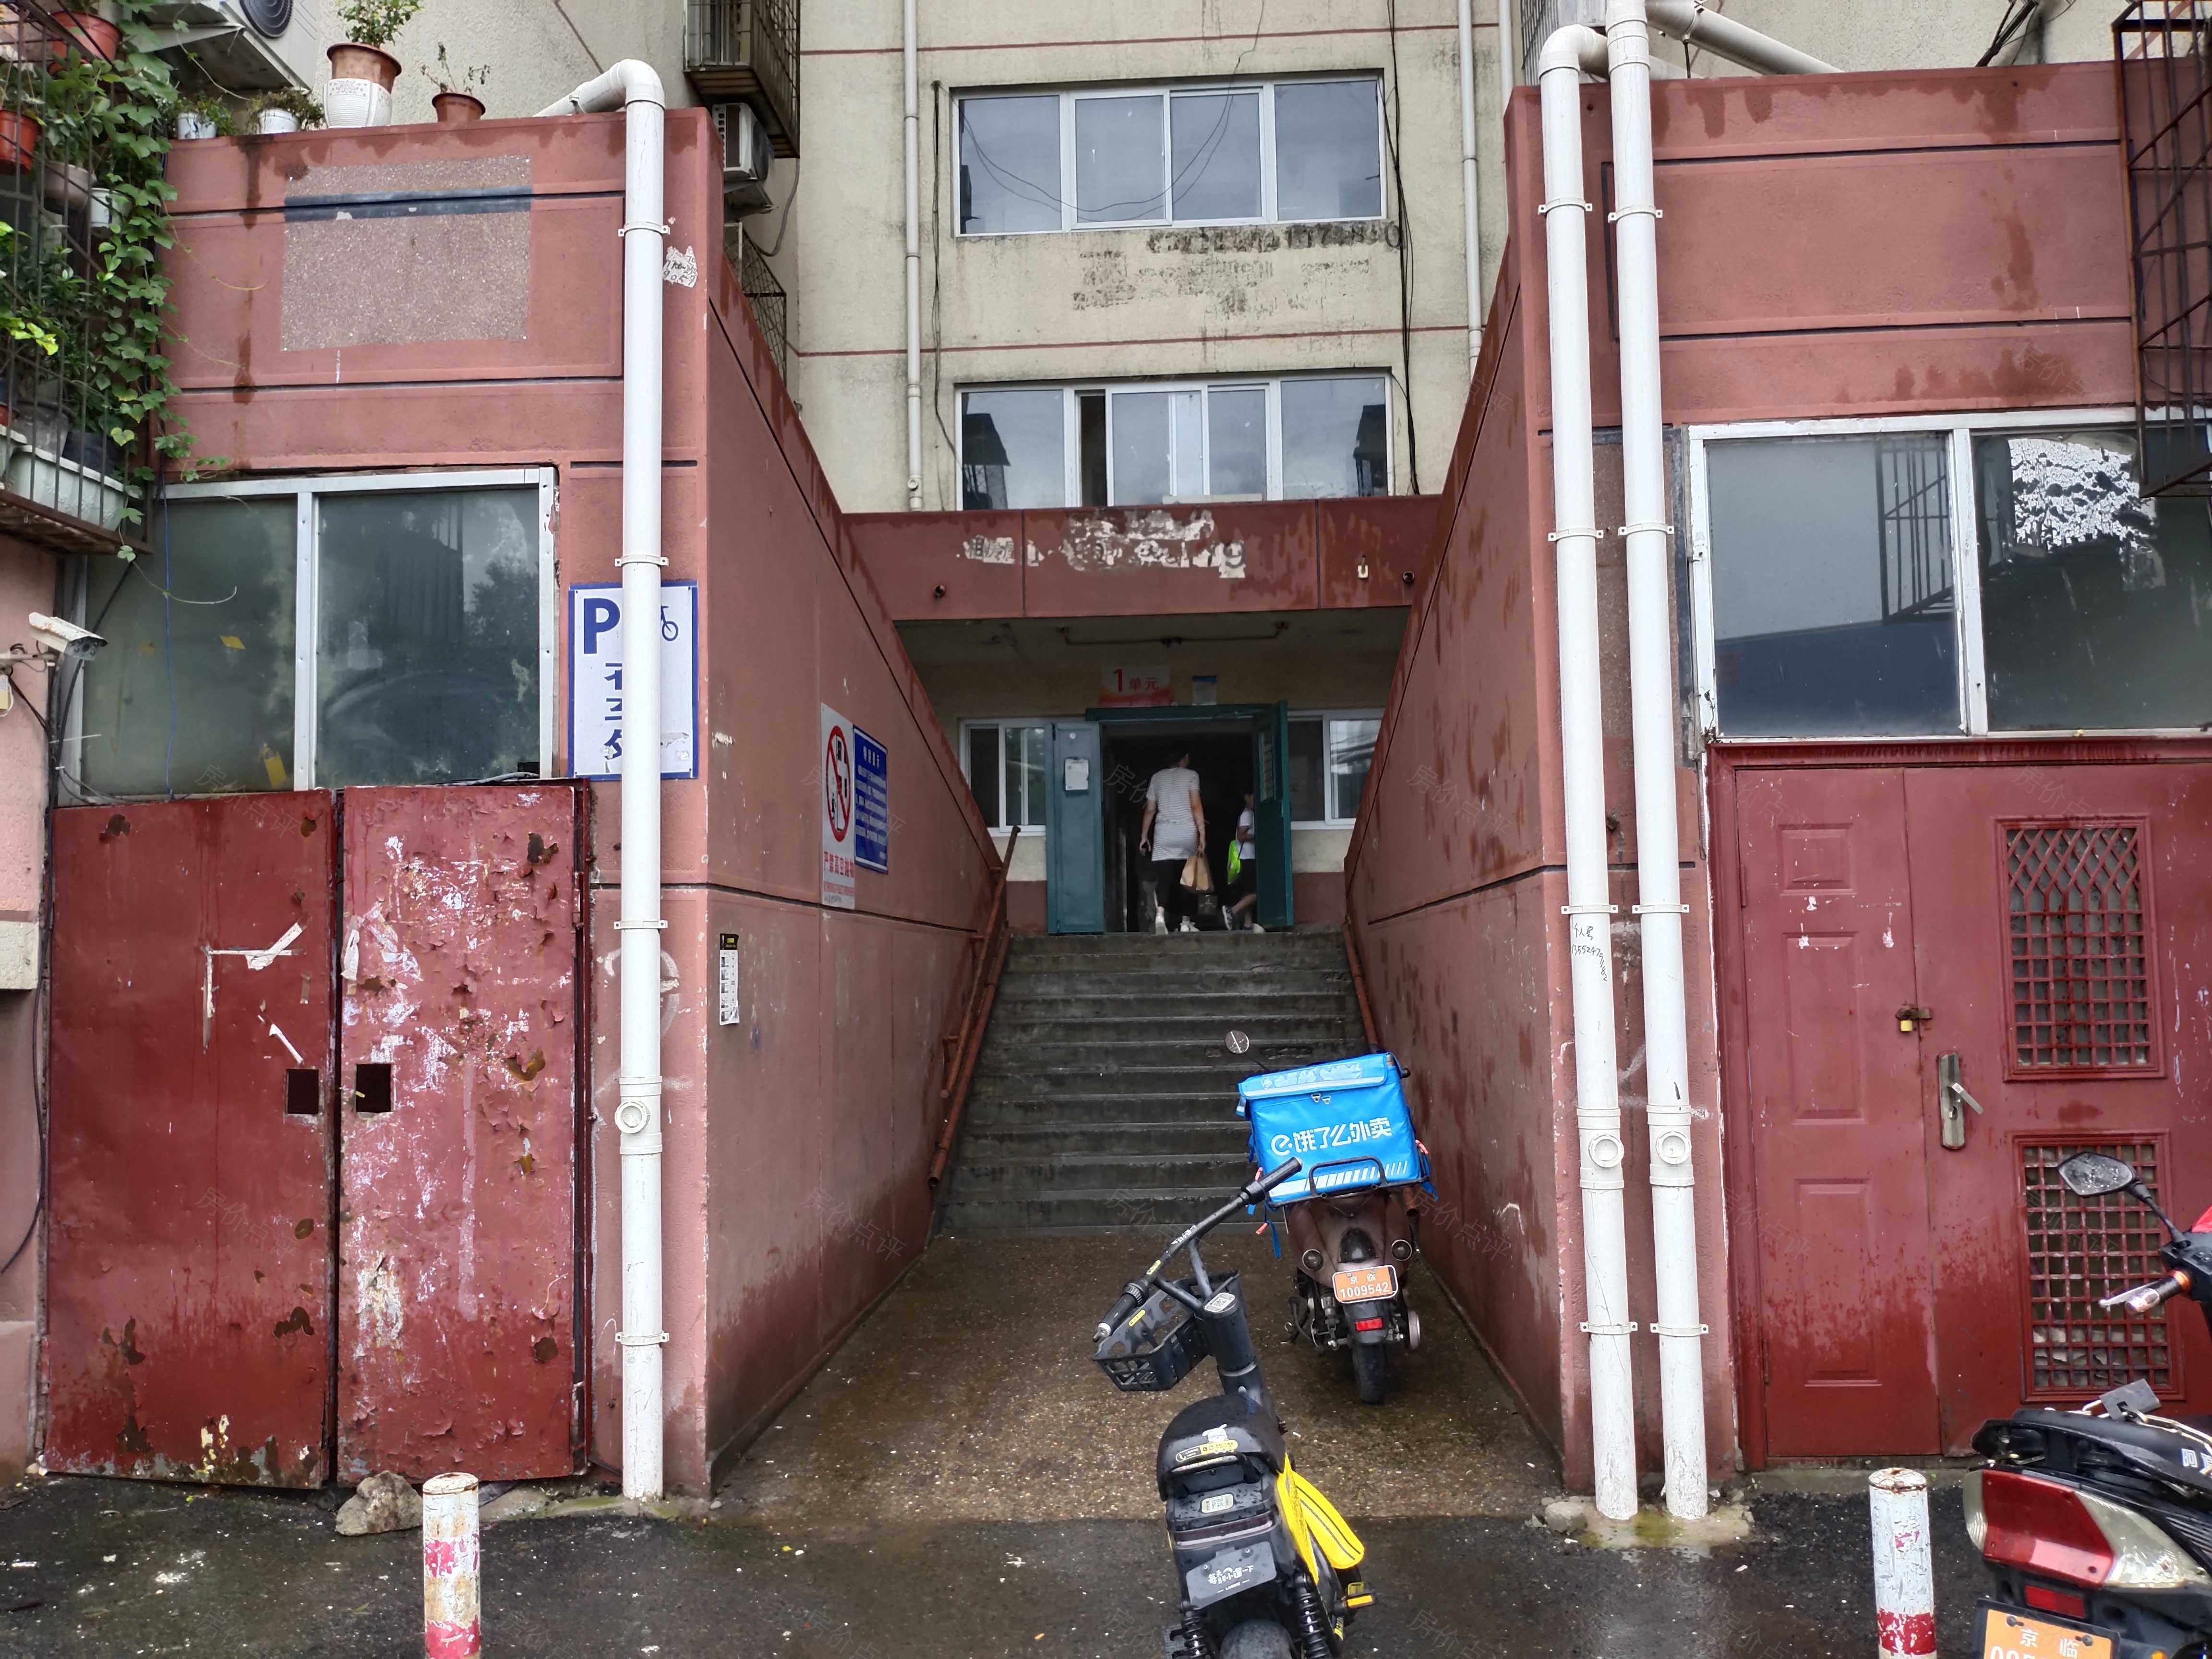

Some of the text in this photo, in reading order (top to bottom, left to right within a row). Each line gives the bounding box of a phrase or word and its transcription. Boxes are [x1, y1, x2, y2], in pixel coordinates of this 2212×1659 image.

[584, 598, 621, 655] P
[1113, 669, 1159, 692] 1单元
[1340, 1282, 1390, 1298] 1009542
[1350, 1276, 1358, 1284] 京
[2019, 1628, 2039, 1647] 京
[2059, 1637, 2080, 1659] 临
